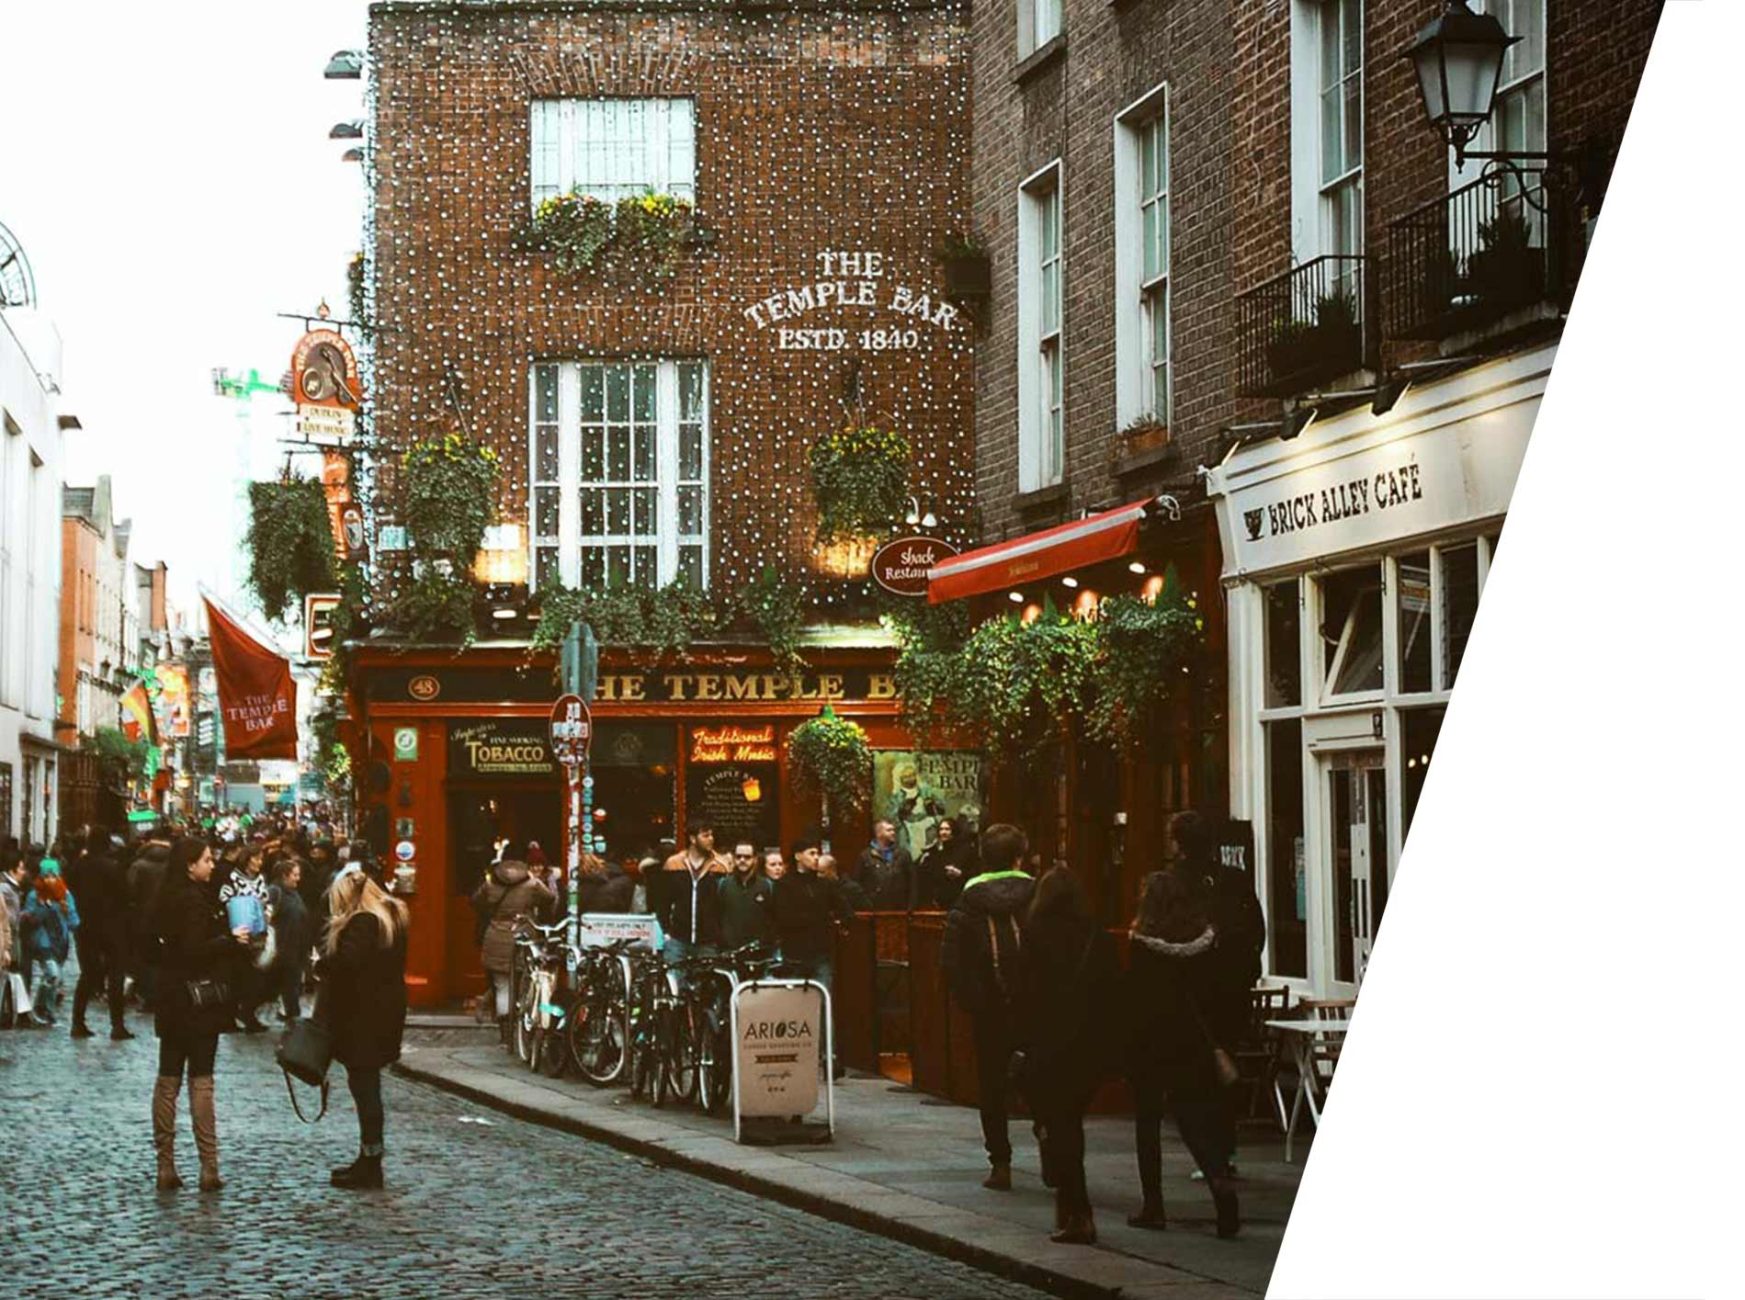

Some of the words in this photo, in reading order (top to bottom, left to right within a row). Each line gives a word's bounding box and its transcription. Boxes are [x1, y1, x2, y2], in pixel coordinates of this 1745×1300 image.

[817, 251, 883, 276] THE
[743, 281, 877, 329] TEMPLE
[890, 286, 957, 331] BAR
[861, 329, 918, 350] 1840
[1268, 493, 1317, 536] BRICK
[1321, 478, 1369, 523] ALLEY
[1374, 451, 1422, 509] CAFÉ
[415, 680, 434, 694] 48
[664, 674, 844, 700] TEMPLE
[245, 694, 270, 706] THE
[246, 714, 275, 732] BAR
[692, 723, 773, 745] Traditional
[465, 740, 545, 768] TOBACCO
[691, 745, 727, 762] Irish
[733, 745, 775, 762] Music
[938, 775, 977, 791] BAR
[743, 1020, 812, 1040] ARIOSA
